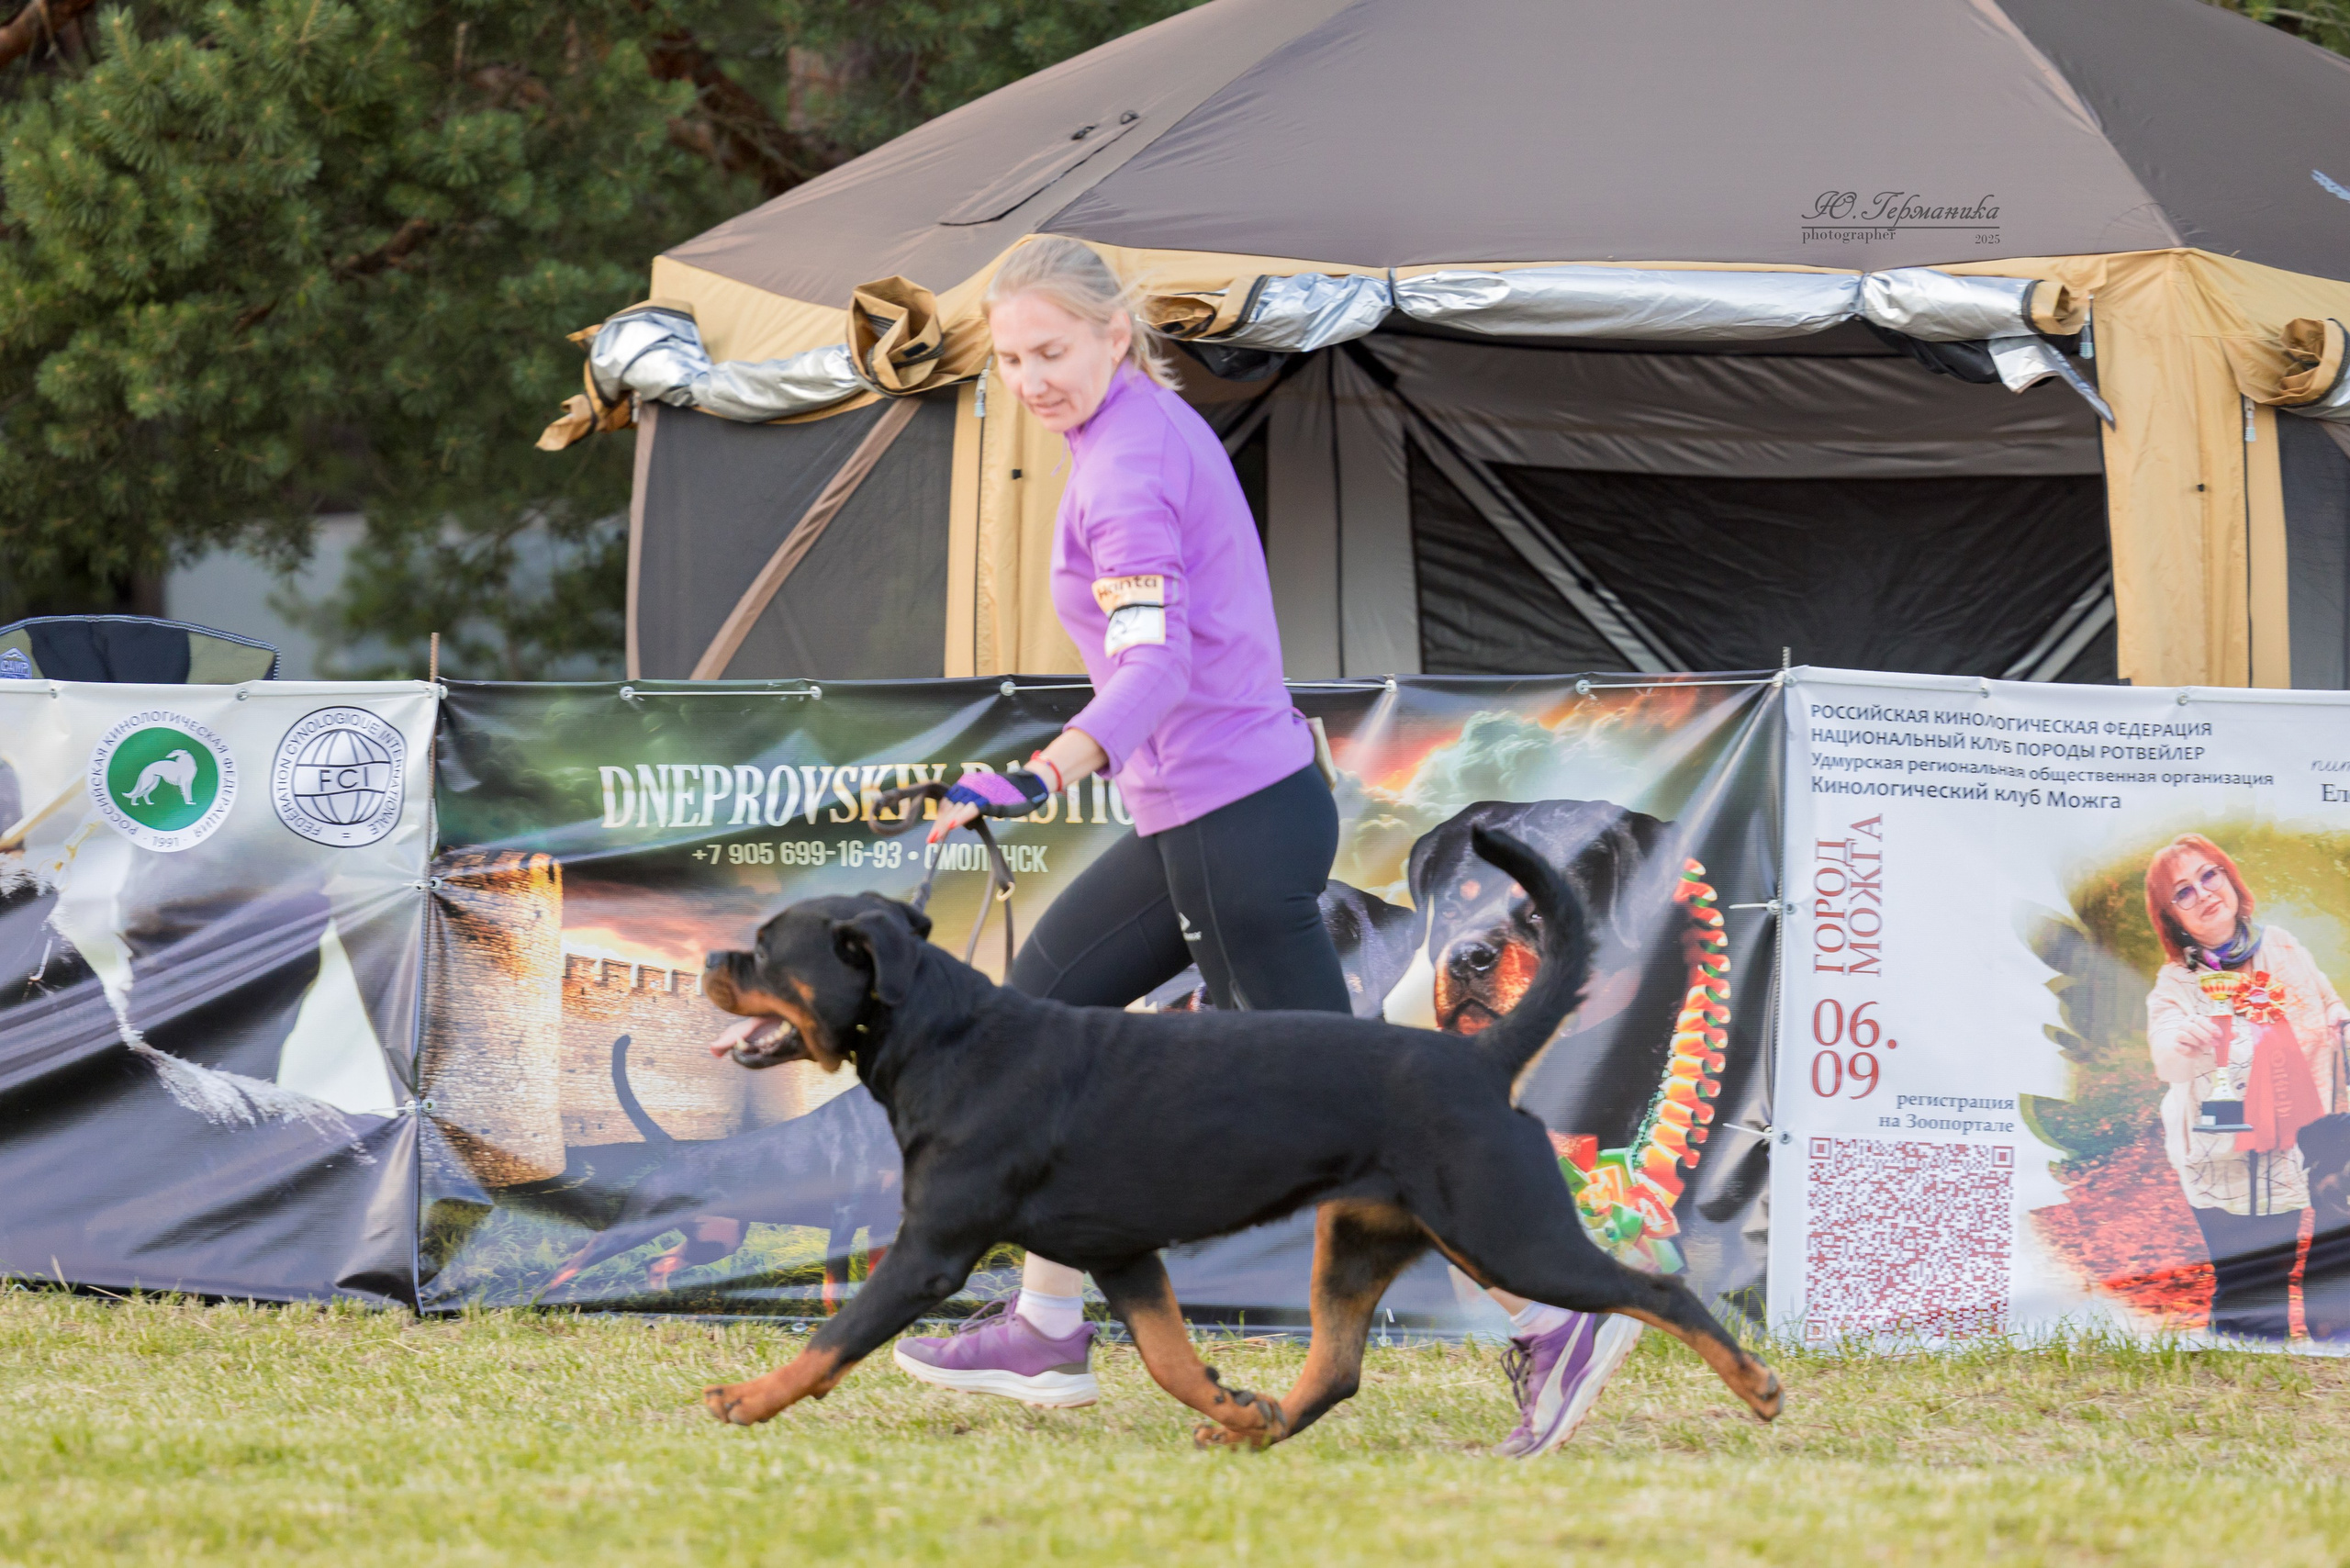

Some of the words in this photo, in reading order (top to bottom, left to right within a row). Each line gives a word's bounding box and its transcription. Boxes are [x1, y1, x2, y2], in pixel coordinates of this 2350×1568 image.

[102, 711, 229, 755] КИНОЛОГИЧЕСКАЯ
[1810, 703, 1930, 723] РОССИЙСКАЯ
[1933, 709, 2098, 734] КИНОЛОГИЧЕСКАЯ
[2102, 722, 2212, 739] ФЕДЕРАЦИЯ
[1810, 727, 1965, 749] НАЦИОНАЛЬНЫЙ
[1970, 735, 2013, 754] КЛУБ
[2016, 742, 2096, 761] ПОРОДЫ
[2100, 745, 2206, 761] РОТВЕЙЛЕР
[285, 712, 381, 756] CYNOLOGIQUE
[367, 730, 404, 835] INTERNATIONALE
[319, 766, 369, 792] FCI
[1908, 759, 2025, 778] региональная
[2029, 767, 2156, 785] общественная
[2162, 773, 2275, 788] организация
[91, 747, 140, 836] РОССИЙСКАЯ
[193, 757, 237, 838] ФЕДЕРАЦИЯ
[598, 764, 947, 828] DNEPROVSKIY
[1810, 776, 1988, 801] Кинологический
[1994, 788, 2042, 808] клуб
[2046, 790, 2121, 810] Можга
[2321, 782, 2350, 803] Ел
[151, 835, 181, 848] 1991
[691, 844, 722, 865] +7
[728, 842, 775, 865] 905
[779, 840, 902, 869] 699-16-93
[924, 842, 1049, 873] СМОЛНСК
[1812, 836, 1857, 974] ГОРОД
[1847, 812, 1883, 978] МОЖГА
[1809, 1049, 1881, 1101] 09
[1896, 1094, 2016, 1113] регистрация
[1878, 1115, 1901, 1128] на
[1906, 1113, 2015, 1136] Зоопортале
